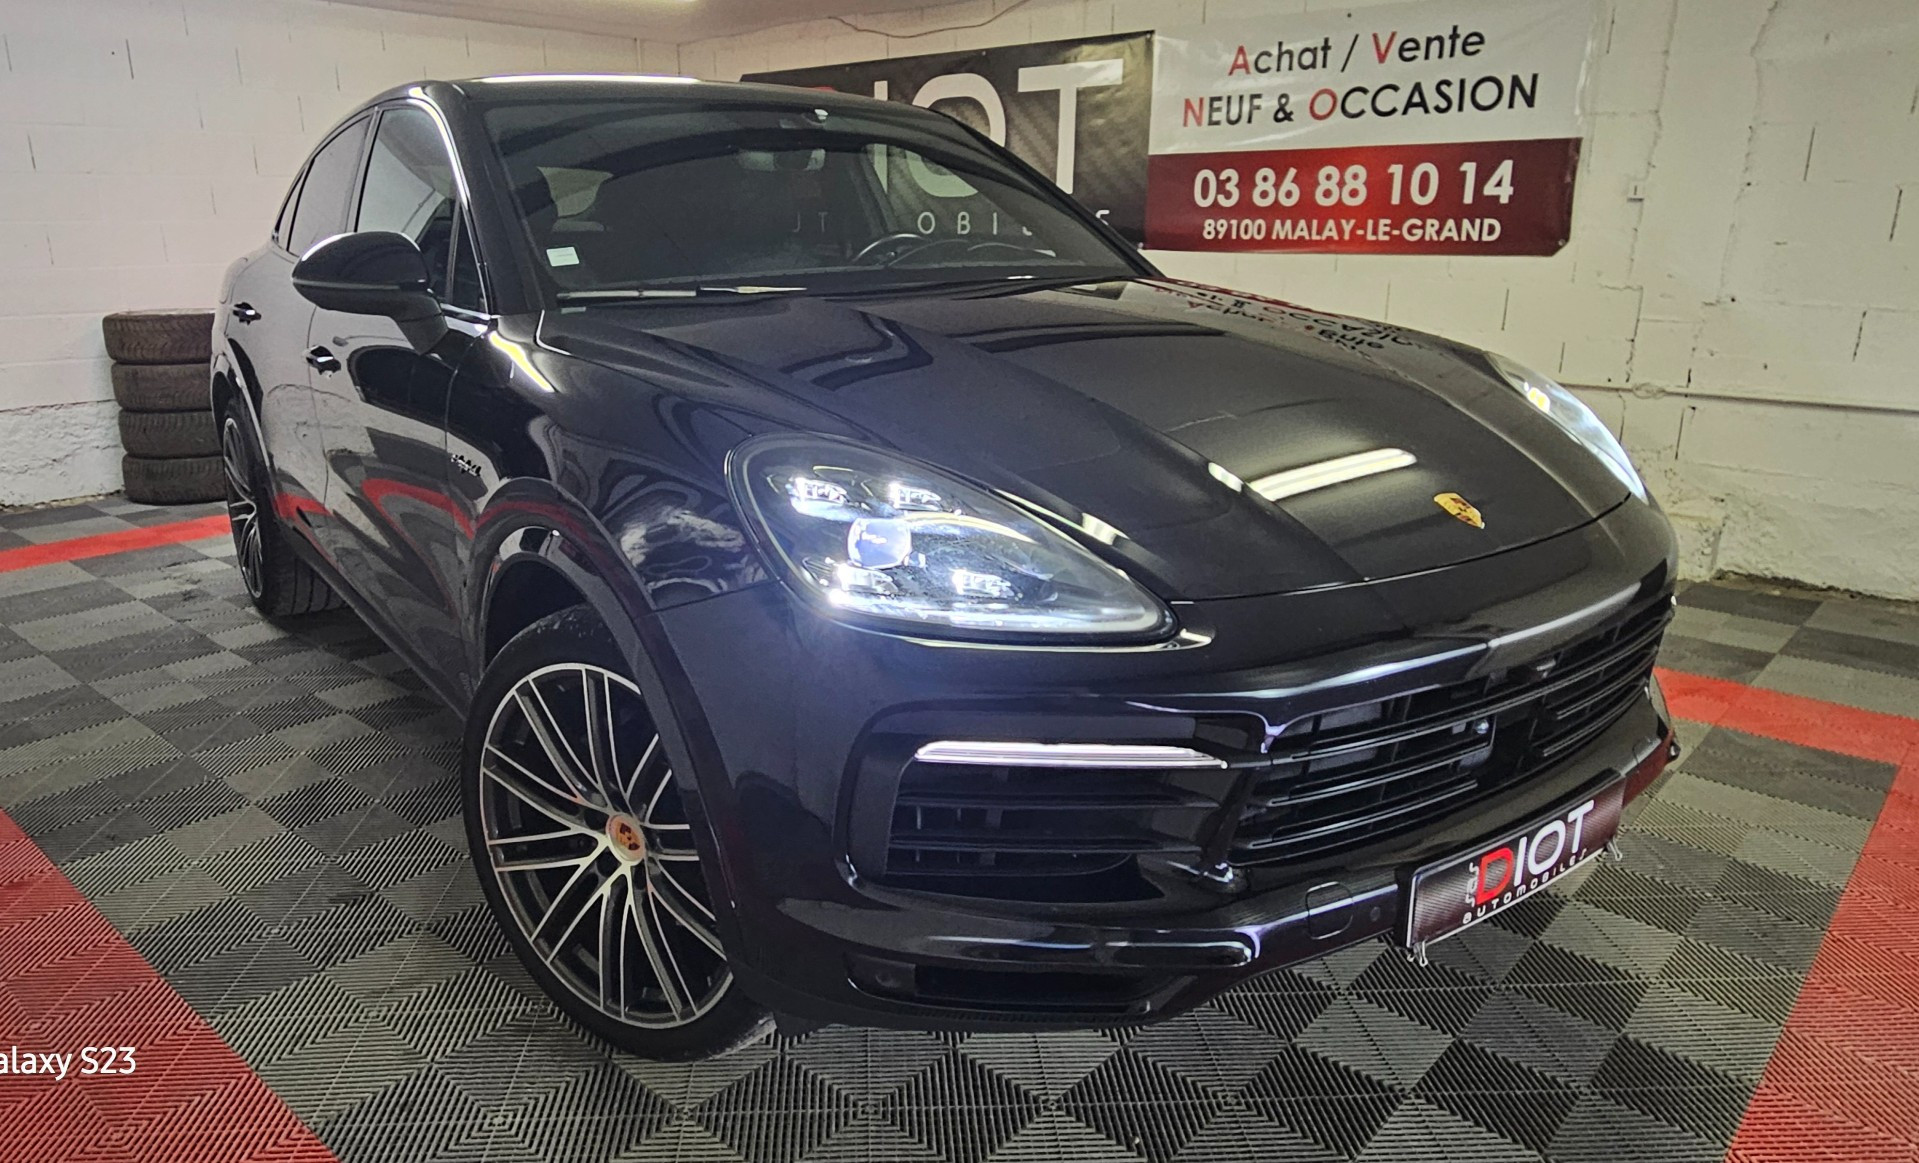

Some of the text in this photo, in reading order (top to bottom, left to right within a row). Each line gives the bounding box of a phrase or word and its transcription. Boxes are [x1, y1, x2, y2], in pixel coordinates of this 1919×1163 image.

[1228, 37, 1332, 76] Achat
[1372, 25, 1485, 64] Vente
[1183, 73, 1539, 128] NEUF & OCCASION
[1193, 159, 1514, 208] 03 86 88 10 14
[1202, 217, 1501, 242] 89100 MALAY-LE-GRAND
[1475, 799, 1594, 904] DIOT
